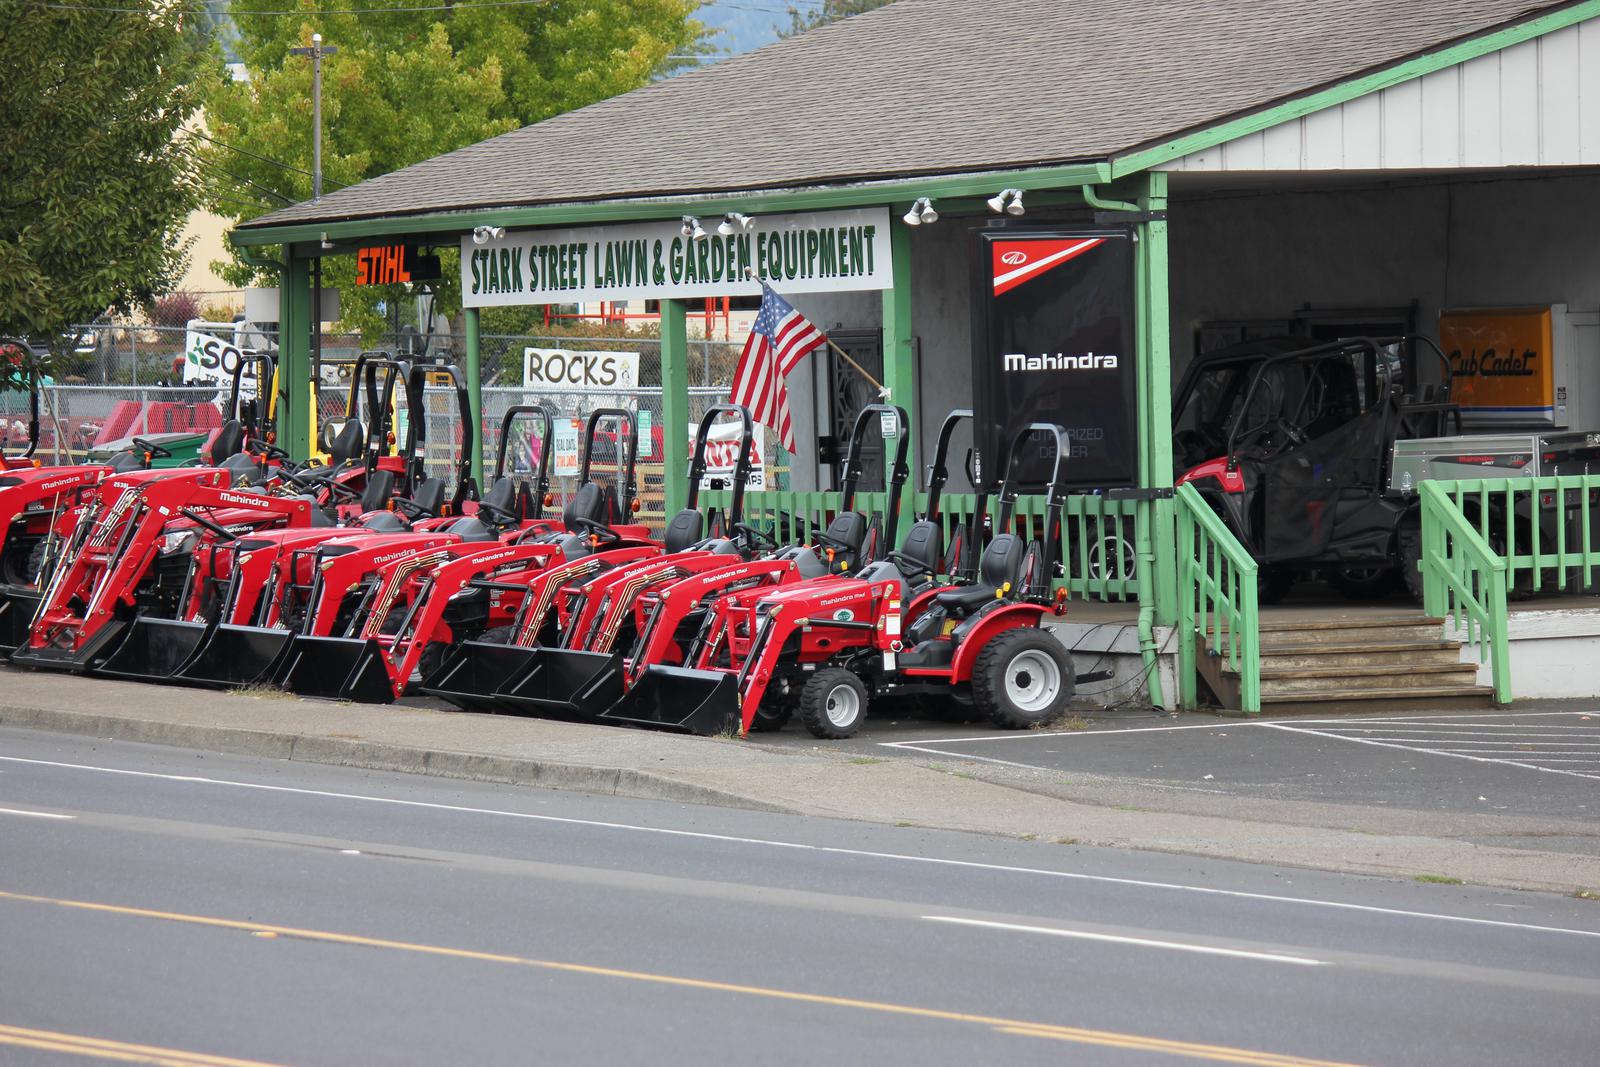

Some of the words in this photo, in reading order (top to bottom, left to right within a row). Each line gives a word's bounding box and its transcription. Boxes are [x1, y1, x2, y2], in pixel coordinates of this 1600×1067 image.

[356, 243, 411, 285] STIHL
[471, 247, 524, 294] STARK
[528, 243, 588, 292] STREET
[594, 239, 648, 288] LAWN
[652, 238, 666, 286] &
[669, 232, 751, 285] GARDEN
[756, 225, 876, 282] EQUIPMENT
[529, 352, 617, 386] ROCKS
[1004, 352, 1118, 371] Mahindra
[1450, 348, 1478, 376] Cub
[1479, 348, 1537, 376] Cadet
[1040, 445, 1088, 458] DEER
[41, 476, 80, 490] Mahindra
[220, 492, 270, 508] Mahindra
[373, 548, 416, 564] Mahindra
[472, 552, 504, 565] Mahindra
[702, 571, 736, 584] Mahindra
[820, 595, 854, 606] Mahindra
